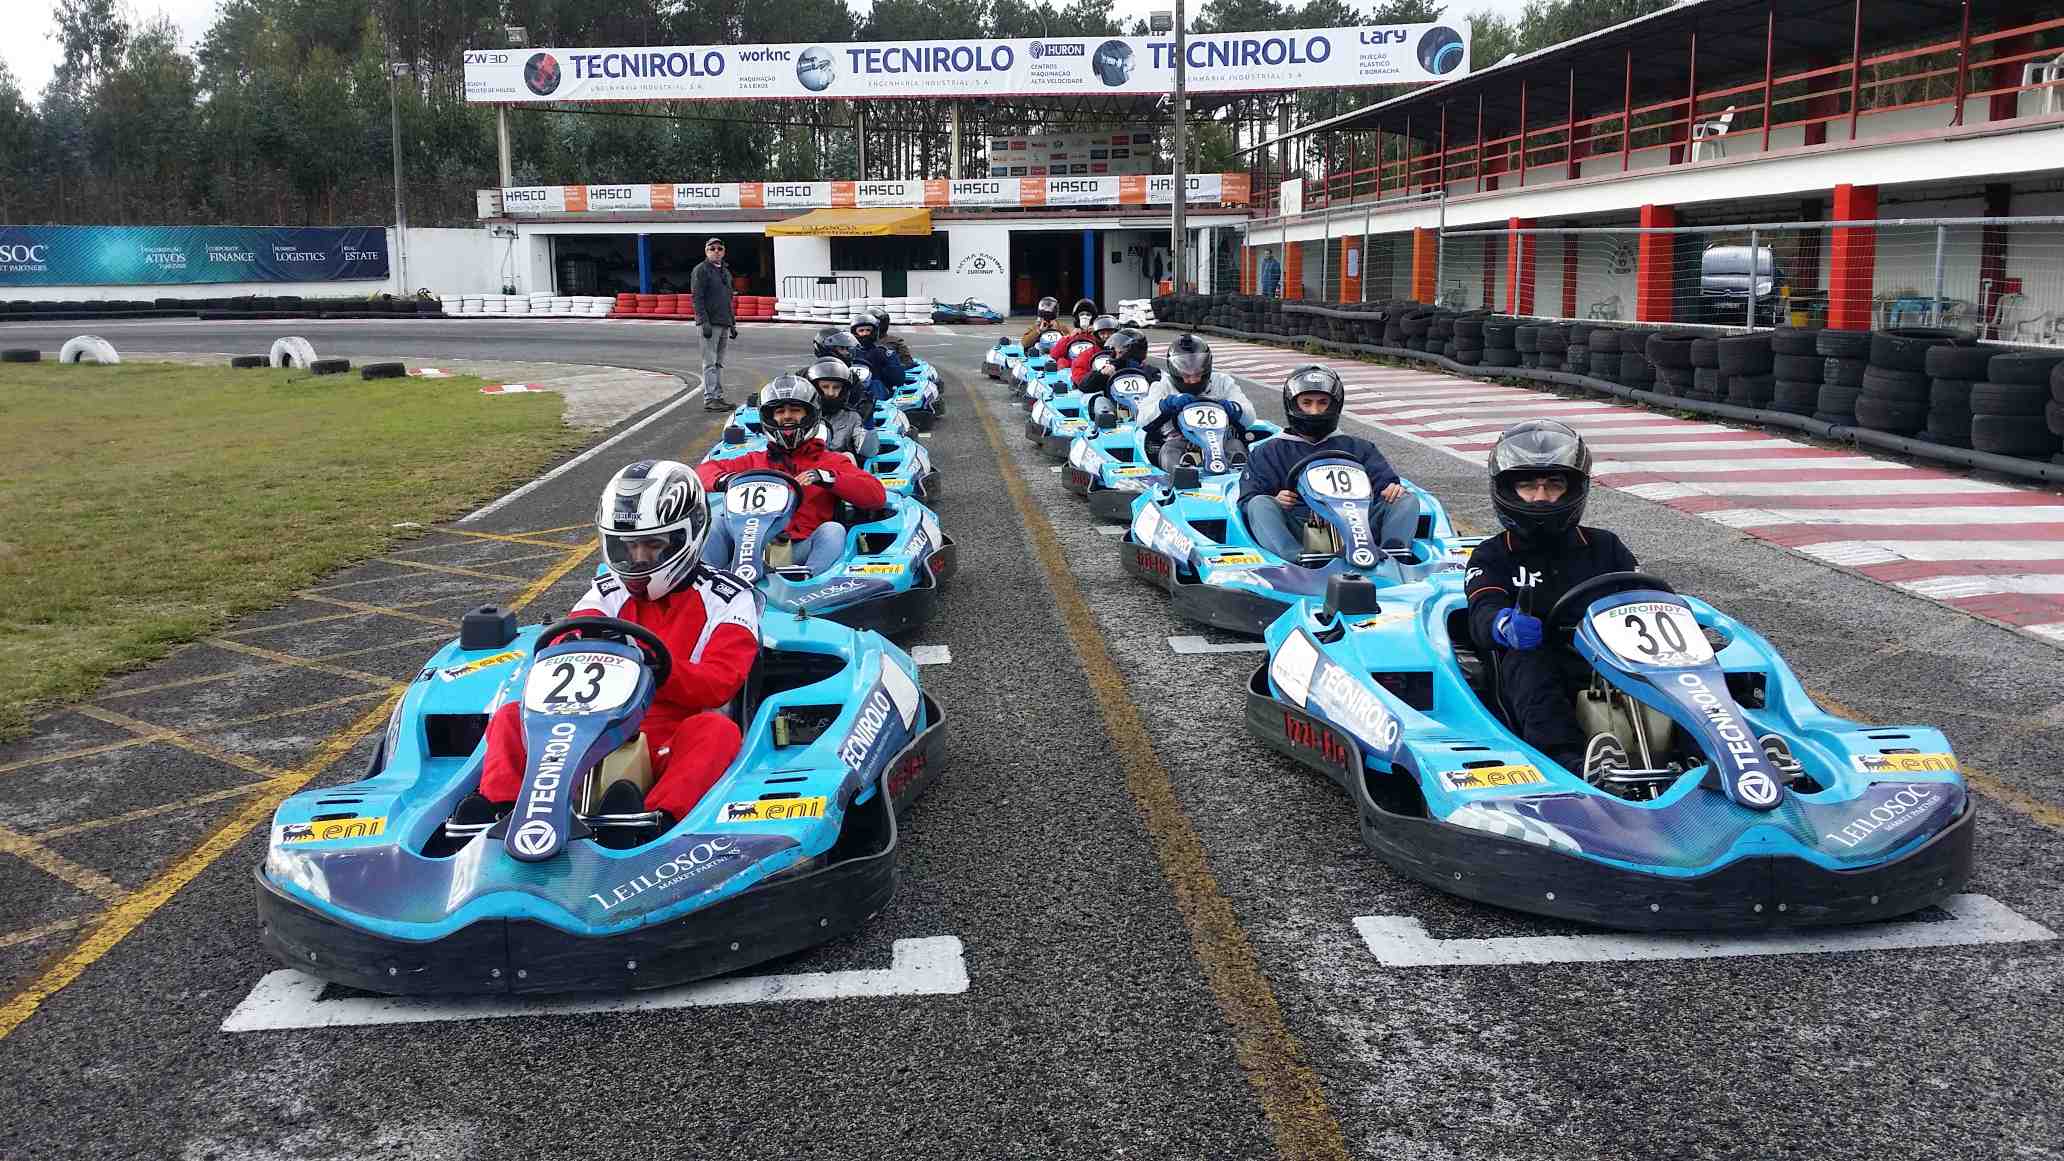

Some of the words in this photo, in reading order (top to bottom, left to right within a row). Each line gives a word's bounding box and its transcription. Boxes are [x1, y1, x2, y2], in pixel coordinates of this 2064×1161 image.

[738, 47, 791, 61] worknc
[1048, 44, 1083, 55] HURON
[569, 51, 726, 79] TECNIROLO
[846, 45, 1015, 73] TECNIROLO
[590, 188, 632, 199] HASCO
[677, 187, 720, 198] HASCO
[767, 186, 811, 197] HASCO
[859, 184, 905, 196] HASCO
[953, 182, 1000, 194] HASCO
[1050, 181, 1098, 193] HASCO
[505, 190, 546, 202] HASCO
[209, 252, 256, 262] FINANCE
[275, 252, 326, 262] LOGISTICS
[344, 252, 379, 261] ESTATE
[1123, 379, 1139, 392] 20
[1195, 409, 1218, 425] 26
[1326, 469, 1353, 493] 19
[739, 486, 767, 510] 16
[1608, 604, 1682, 619] EUROINDY
[1624, 611, 1687, 655] 30
[544, 654, 624, 668] EUROINDY
[543, 662, 606, 704] 23
[1319, 662, 1399, 747] TECNIROLO
[1677, 673, 1761, 771] TECNIROLO
[525, 722, 577, 819] TECNIROLO
[1900, 757, 1955, 771] eni
[1487, 769, 1540, 785] eni
[765, 801, 818, 820] eni
[1824, 783, 1931, 848] LEILOSOC
[322, 821, 378, 841] eni
[588, 836, 734, 911] LEILOSOC
